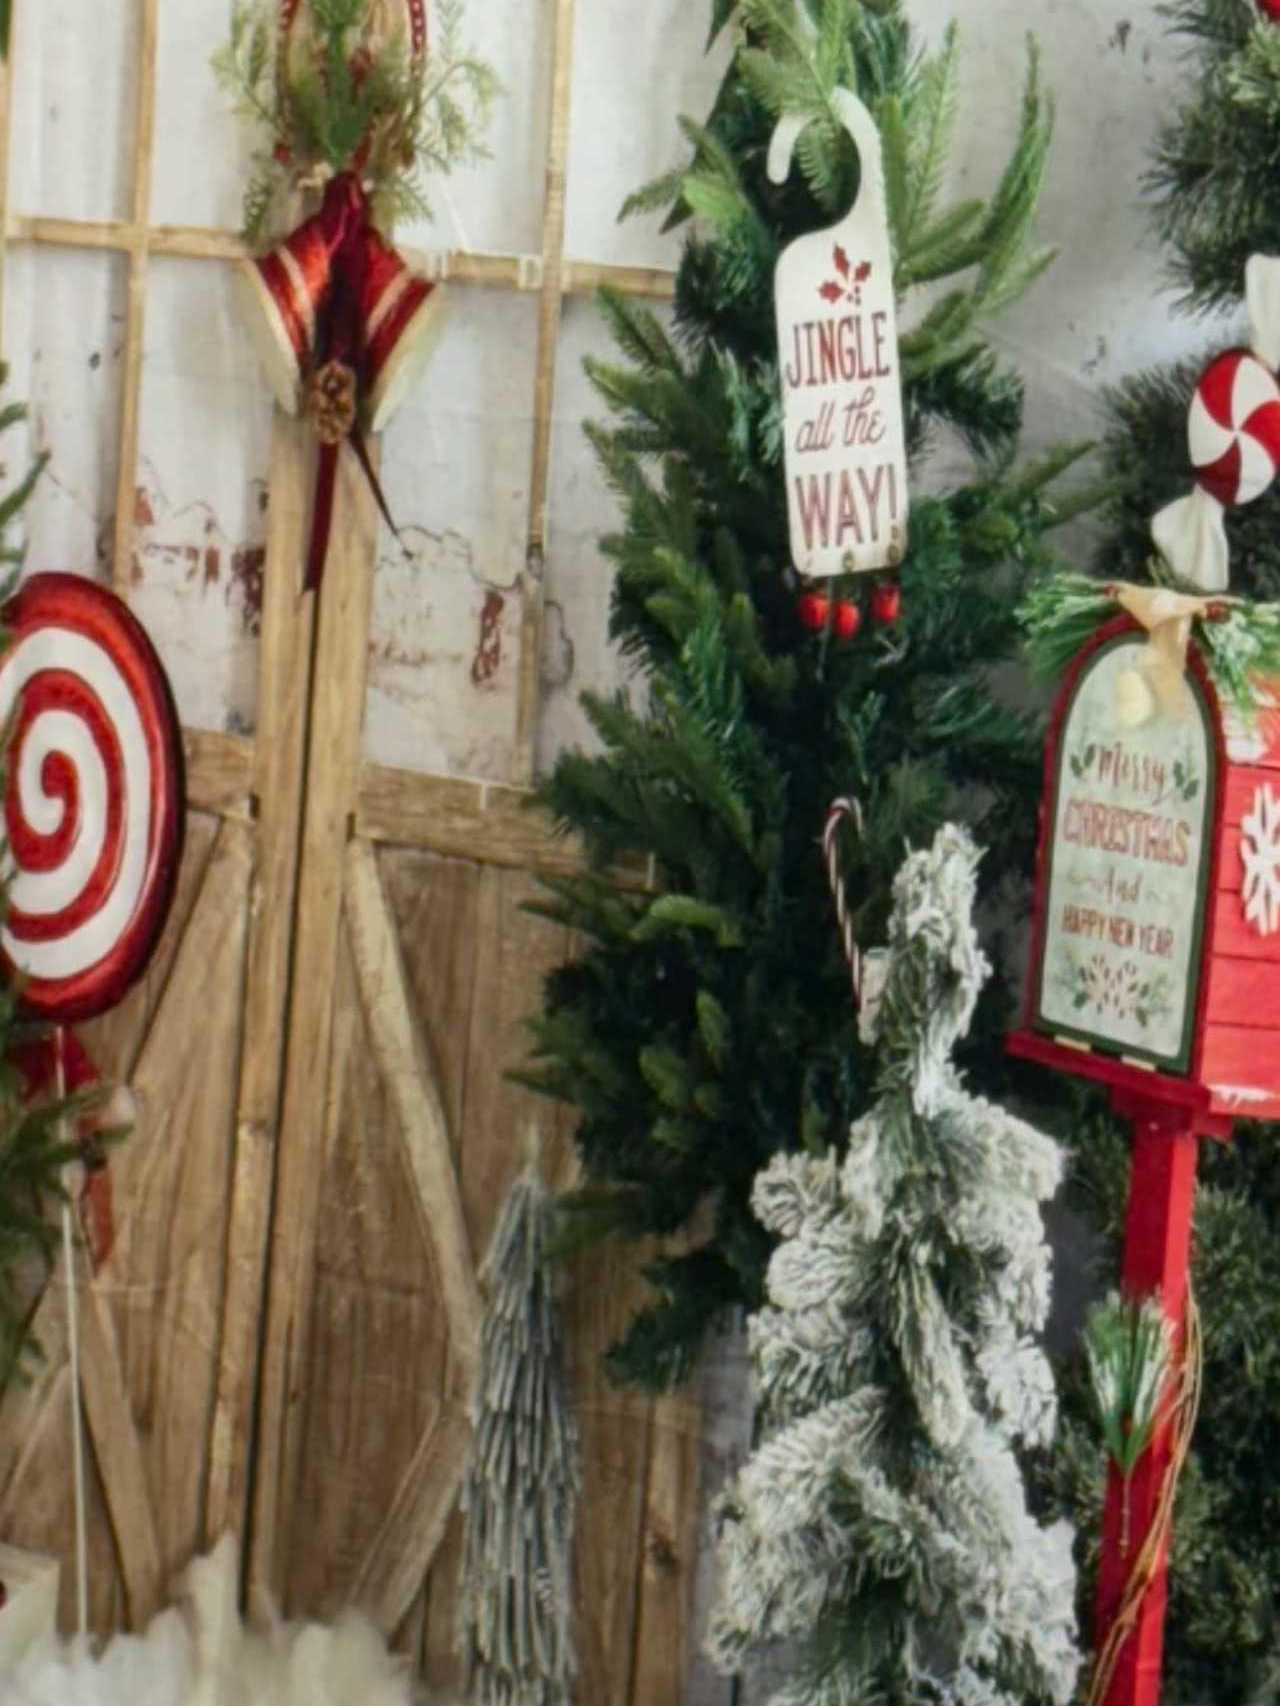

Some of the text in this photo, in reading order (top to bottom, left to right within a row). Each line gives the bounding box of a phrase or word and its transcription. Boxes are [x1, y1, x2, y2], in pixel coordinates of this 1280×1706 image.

[786, 310, 891, 389] JINGLE
[794, 385, 886, 454] all the
[794, 462, 900, 551] WAY!
[1062, 797, 1192, 868] CHRISTMAS
[1061, 904, 1174, 959] HAPPY NEW YEAR
